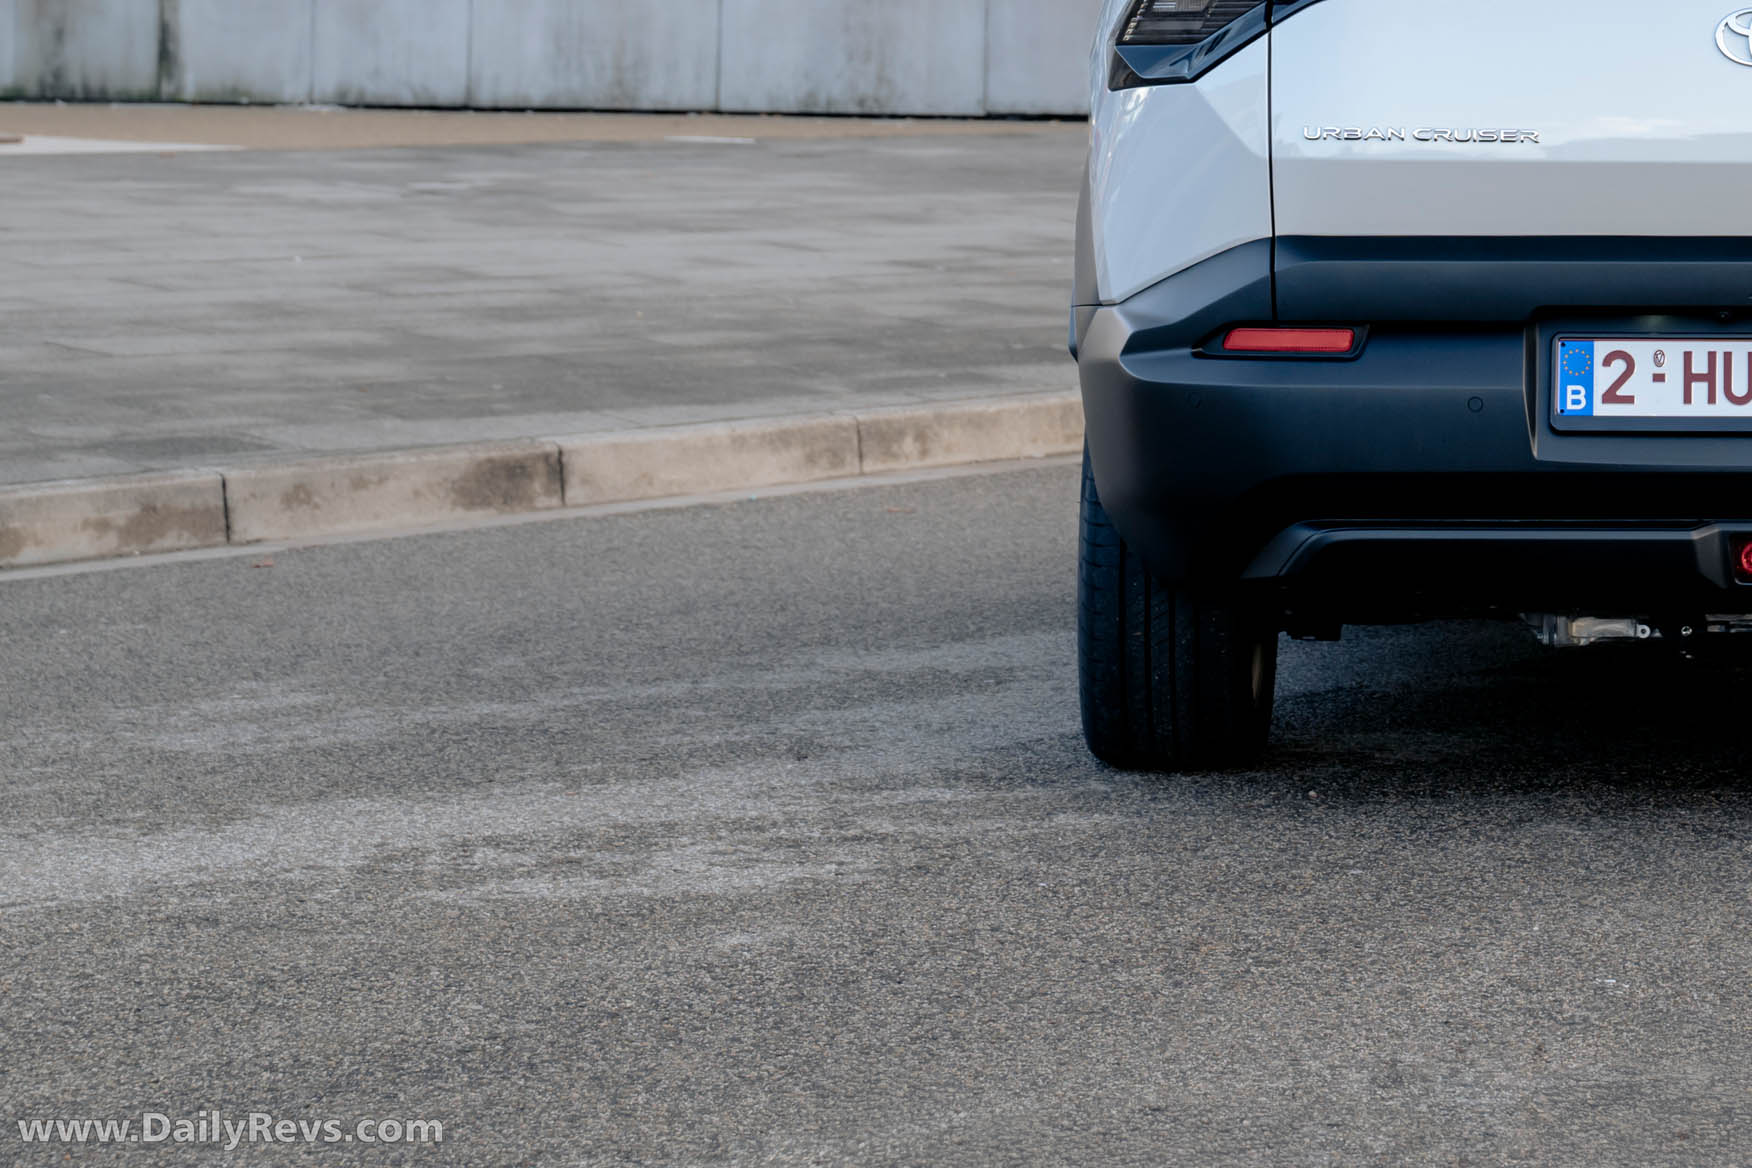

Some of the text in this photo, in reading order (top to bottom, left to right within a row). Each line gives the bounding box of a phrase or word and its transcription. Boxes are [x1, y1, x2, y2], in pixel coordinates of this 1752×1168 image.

[1303, 126, 1540, 144] URBAN CRUISER
[1566, 385, 1587, 411] B
